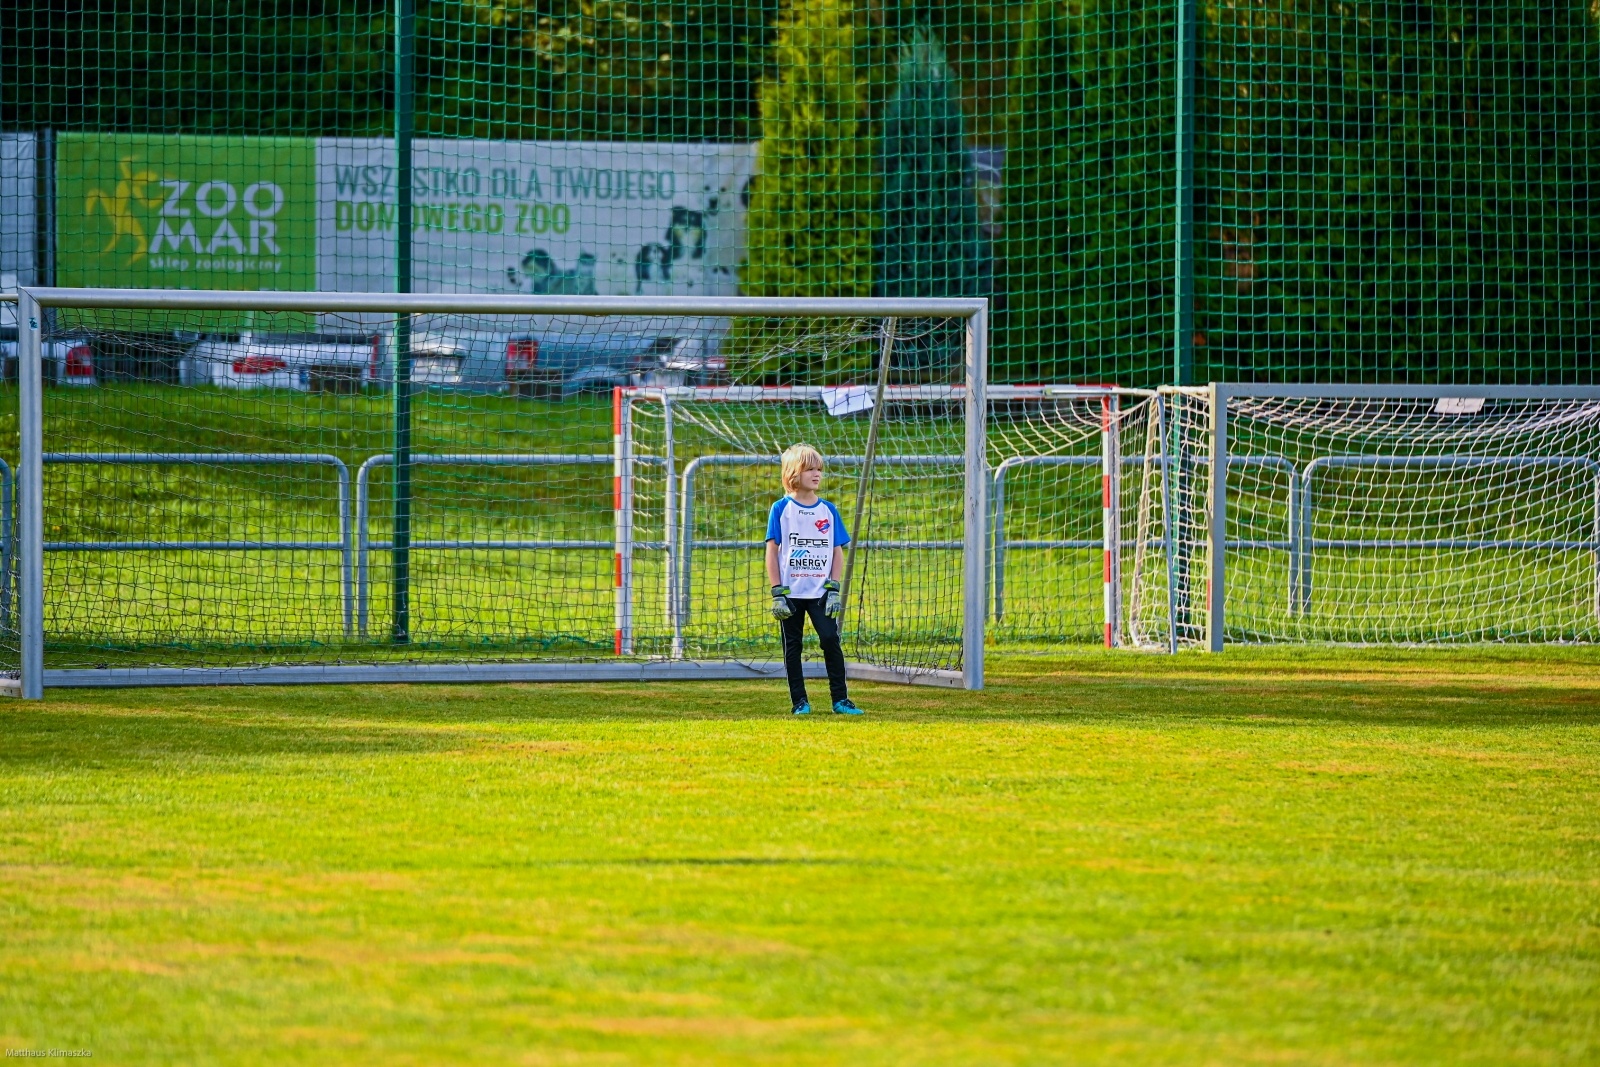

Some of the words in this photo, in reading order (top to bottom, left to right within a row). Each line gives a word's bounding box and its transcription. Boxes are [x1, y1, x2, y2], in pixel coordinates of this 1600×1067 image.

[159, 179, 284, 217] ZOO
[336, 166, 480, 197] WSZSTKO
[492, 167, 542, 198] DLA
[551, 168, 675, 200] TWOJEGO
[515, 203, 570, 234] ZOO
[149, 218, 281, 255] MAR
[150, 257, 189, 271] sklep
[196, 257, 282, 273] zoologiczny
[789, 558, 828, 567] ENERGY
